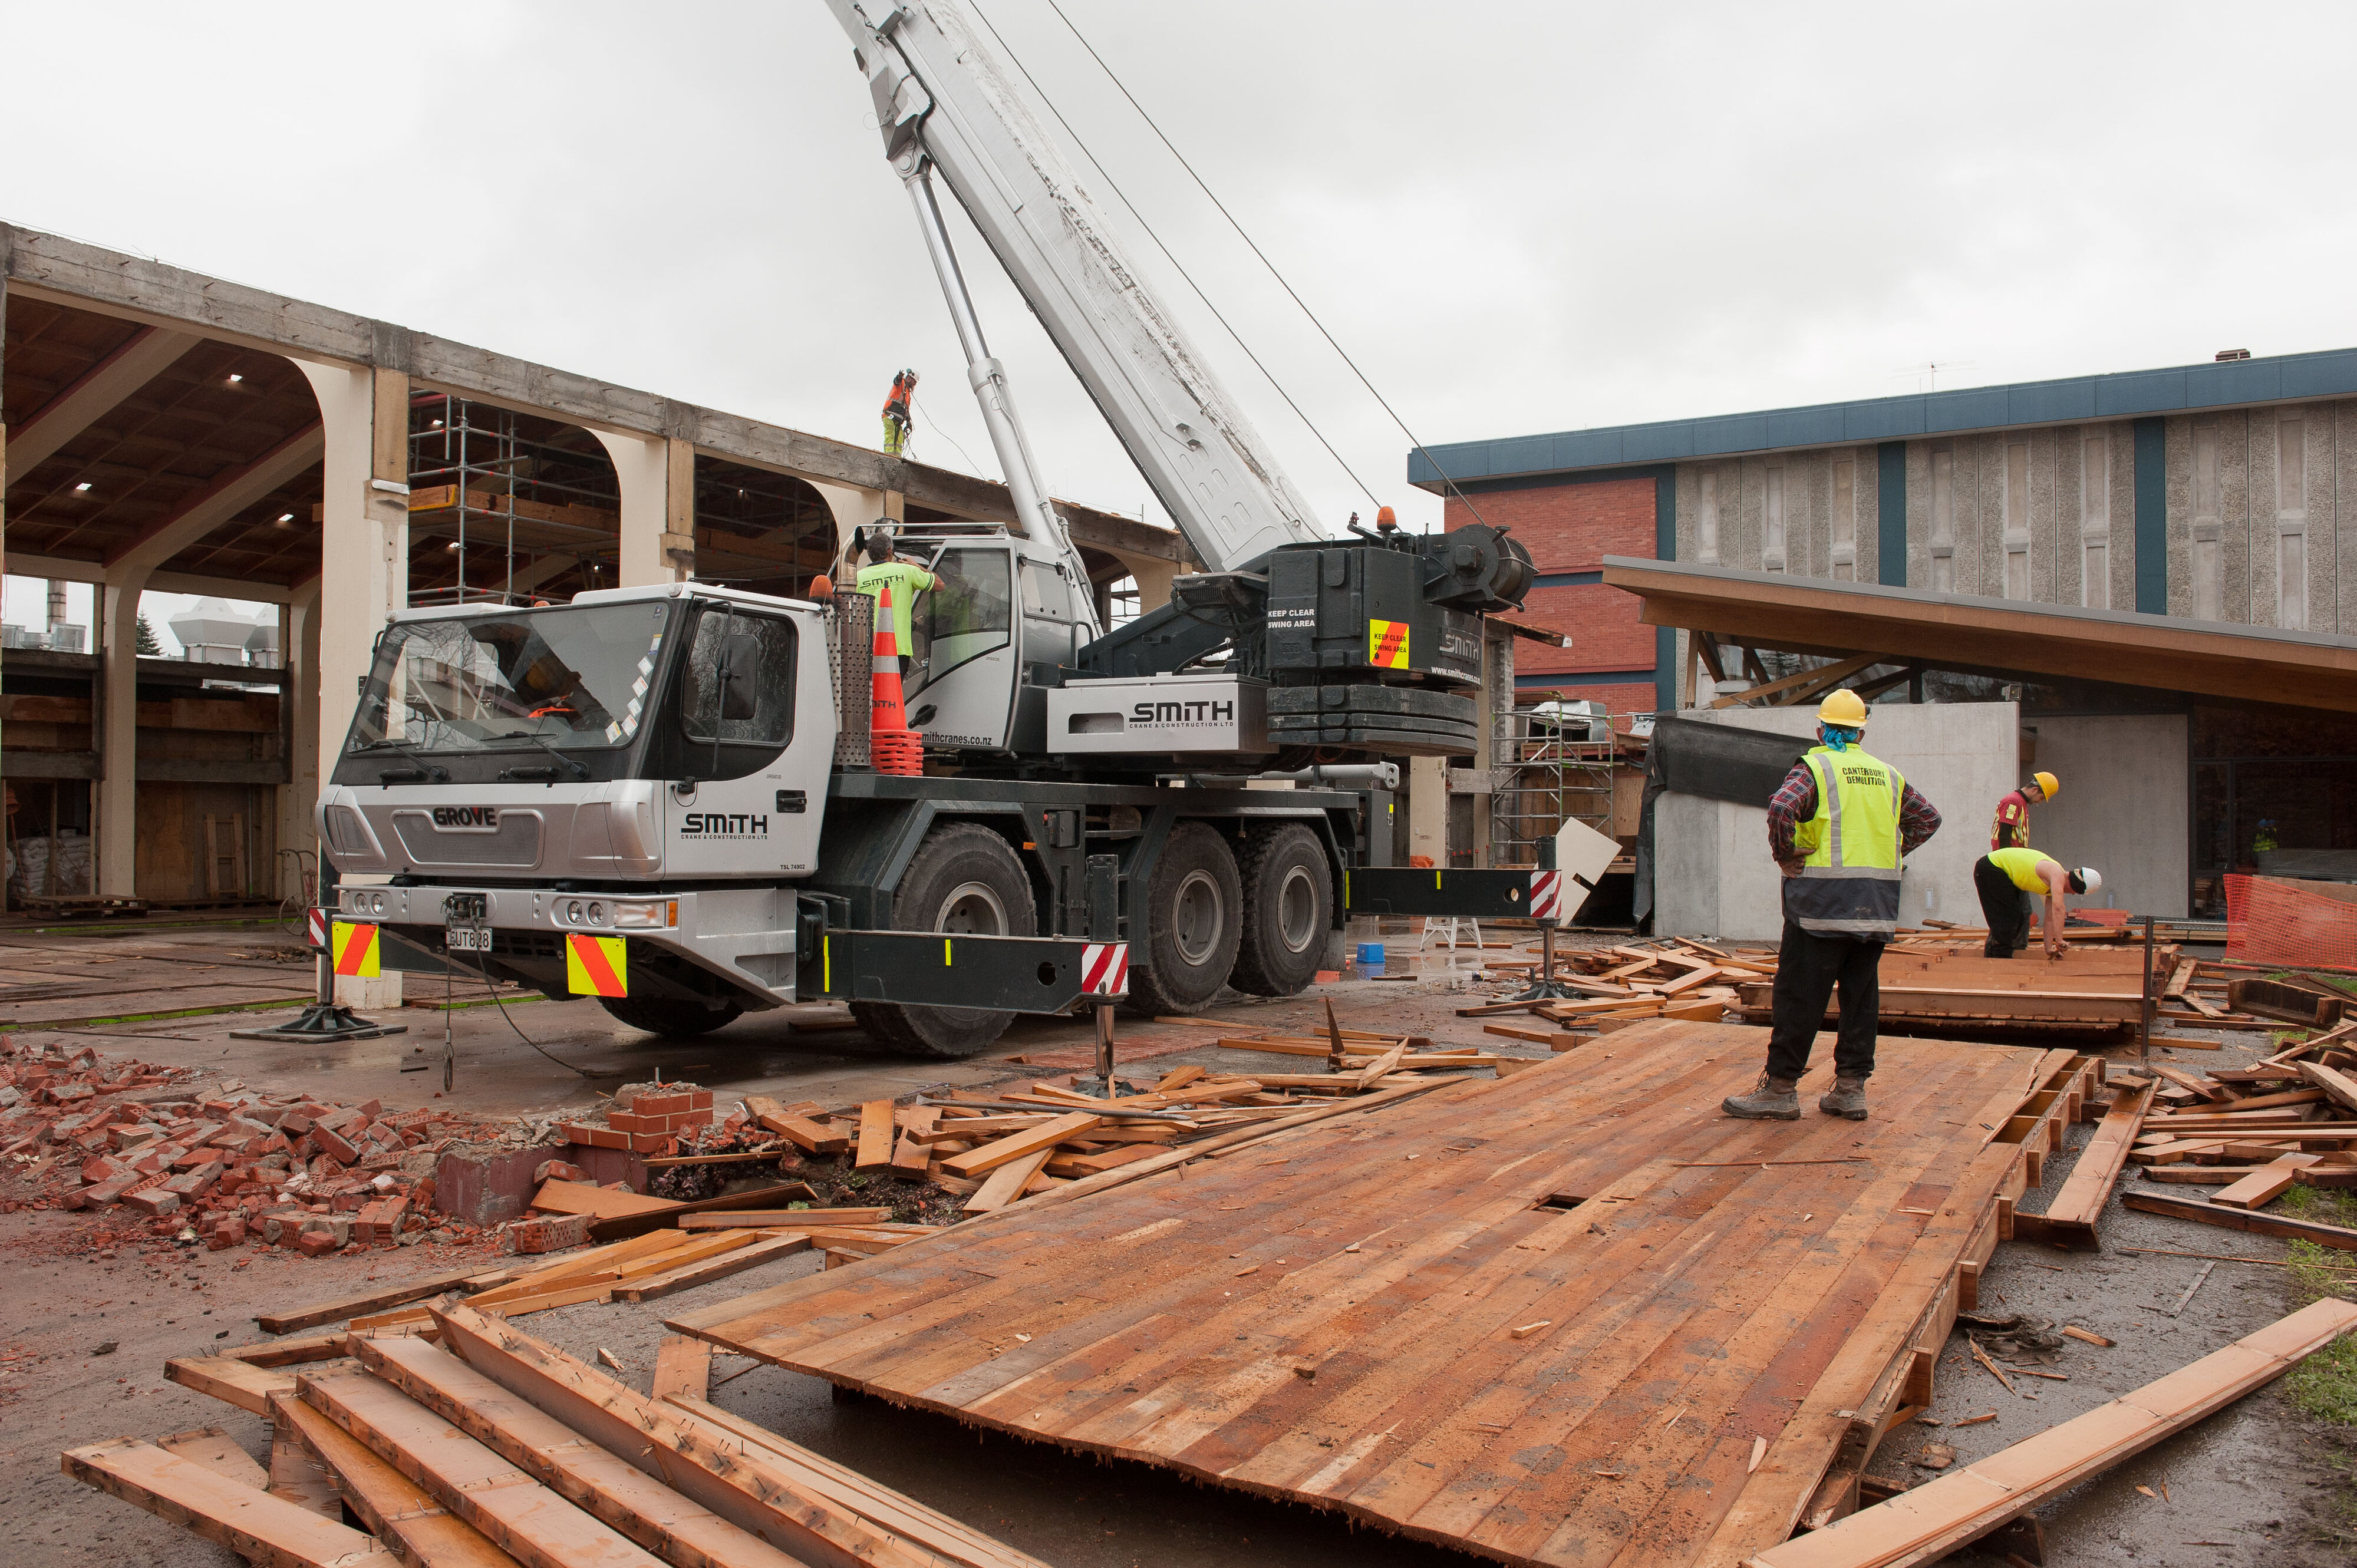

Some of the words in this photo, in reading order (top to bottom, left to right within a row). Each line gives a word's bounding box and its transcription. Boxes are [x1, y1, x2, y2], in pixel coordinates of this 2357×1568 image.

[860, 575, 904, 588] SMTH
[1268, 620, 1292, 629] SWING
[1439, 633, 1479, 660] SMITH
[1129, 701, 1233, 722] SMITH
[922, 731, 992, 745] mithcranes.co.nz
[1842, 767, 1885, 778] CANTERBURY
[1846, 776, 1886, 787] DEMOLITION
[433, 807, 497, 826] GROVE
[681, 813, 767, 834] SMITH
